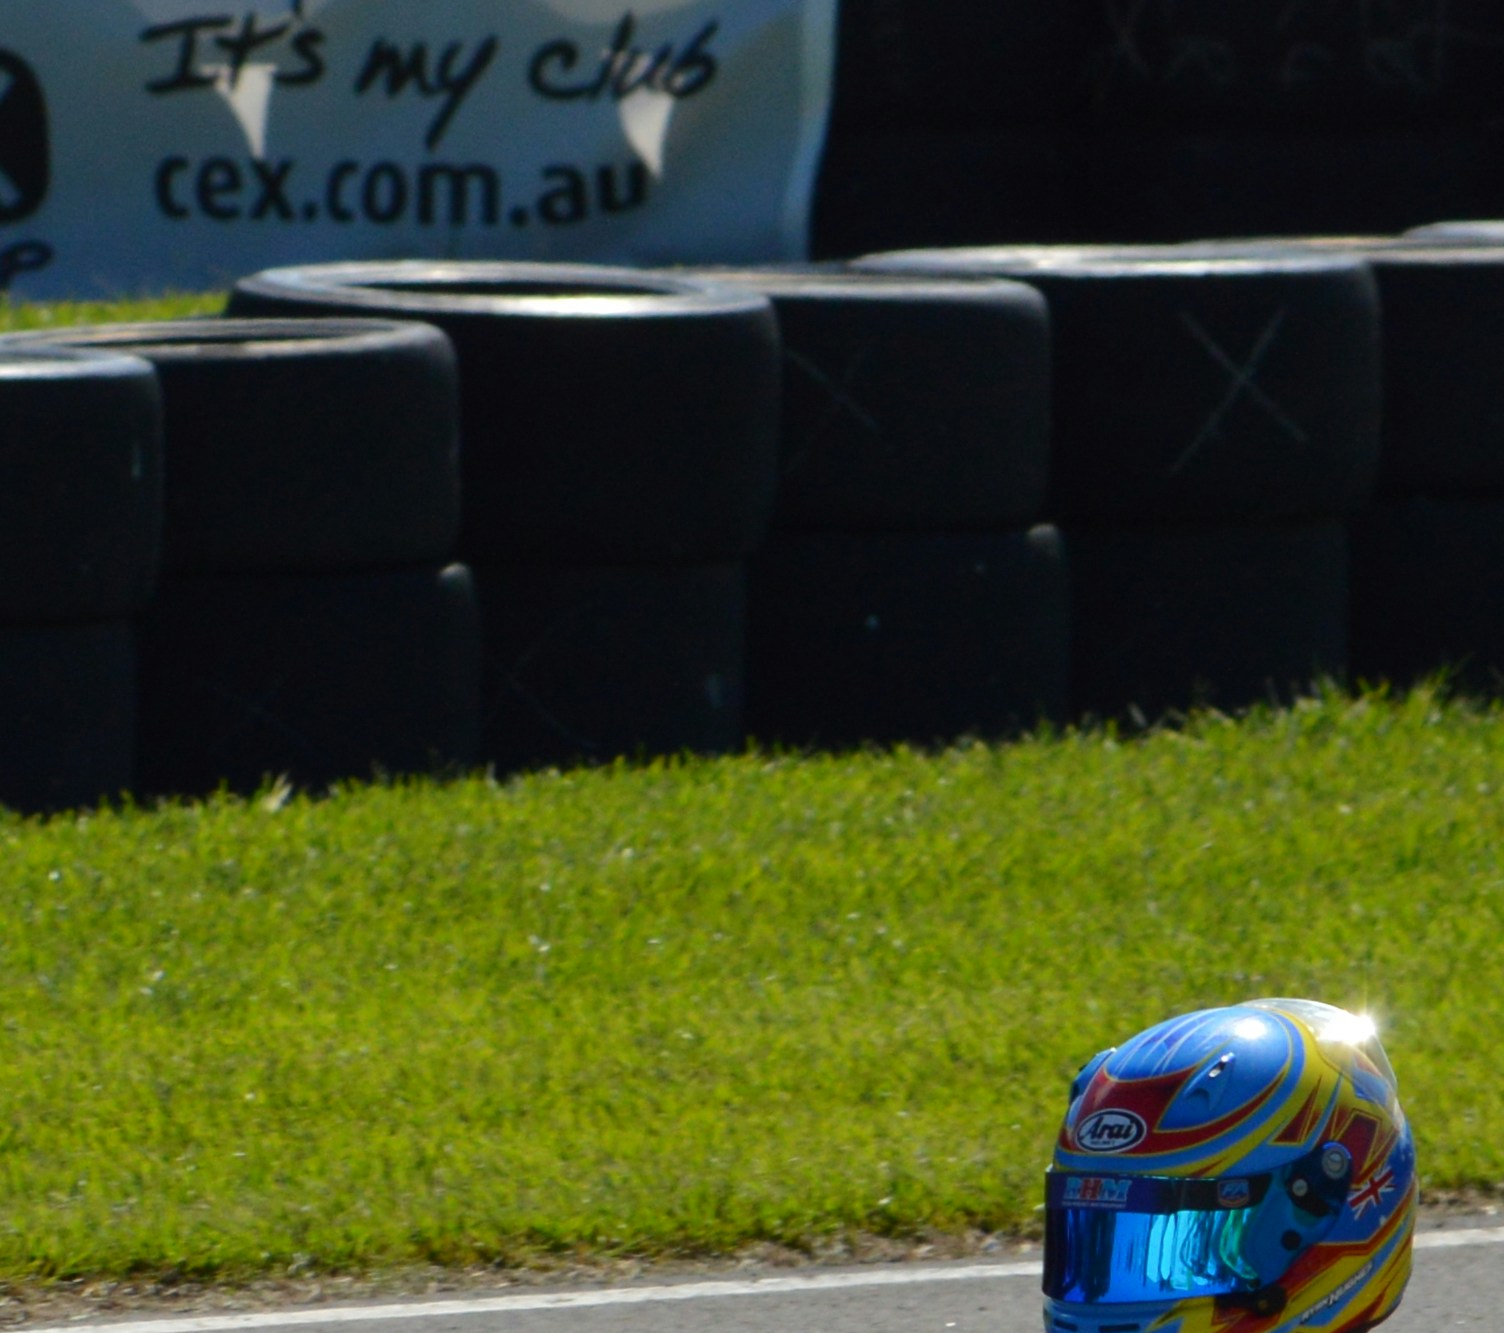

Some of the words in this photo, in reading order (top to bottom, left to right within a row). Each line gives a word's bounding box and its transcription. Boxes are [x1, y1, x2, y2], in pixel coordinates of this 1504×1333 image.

[140, 4, 328, 93] It's
[354, 33, 501, 151] my
[528, 10, 718, 99] club
[153, 150, 652, 228] cex.com.au
[1079, 1115, 1136, 1140] Arai
